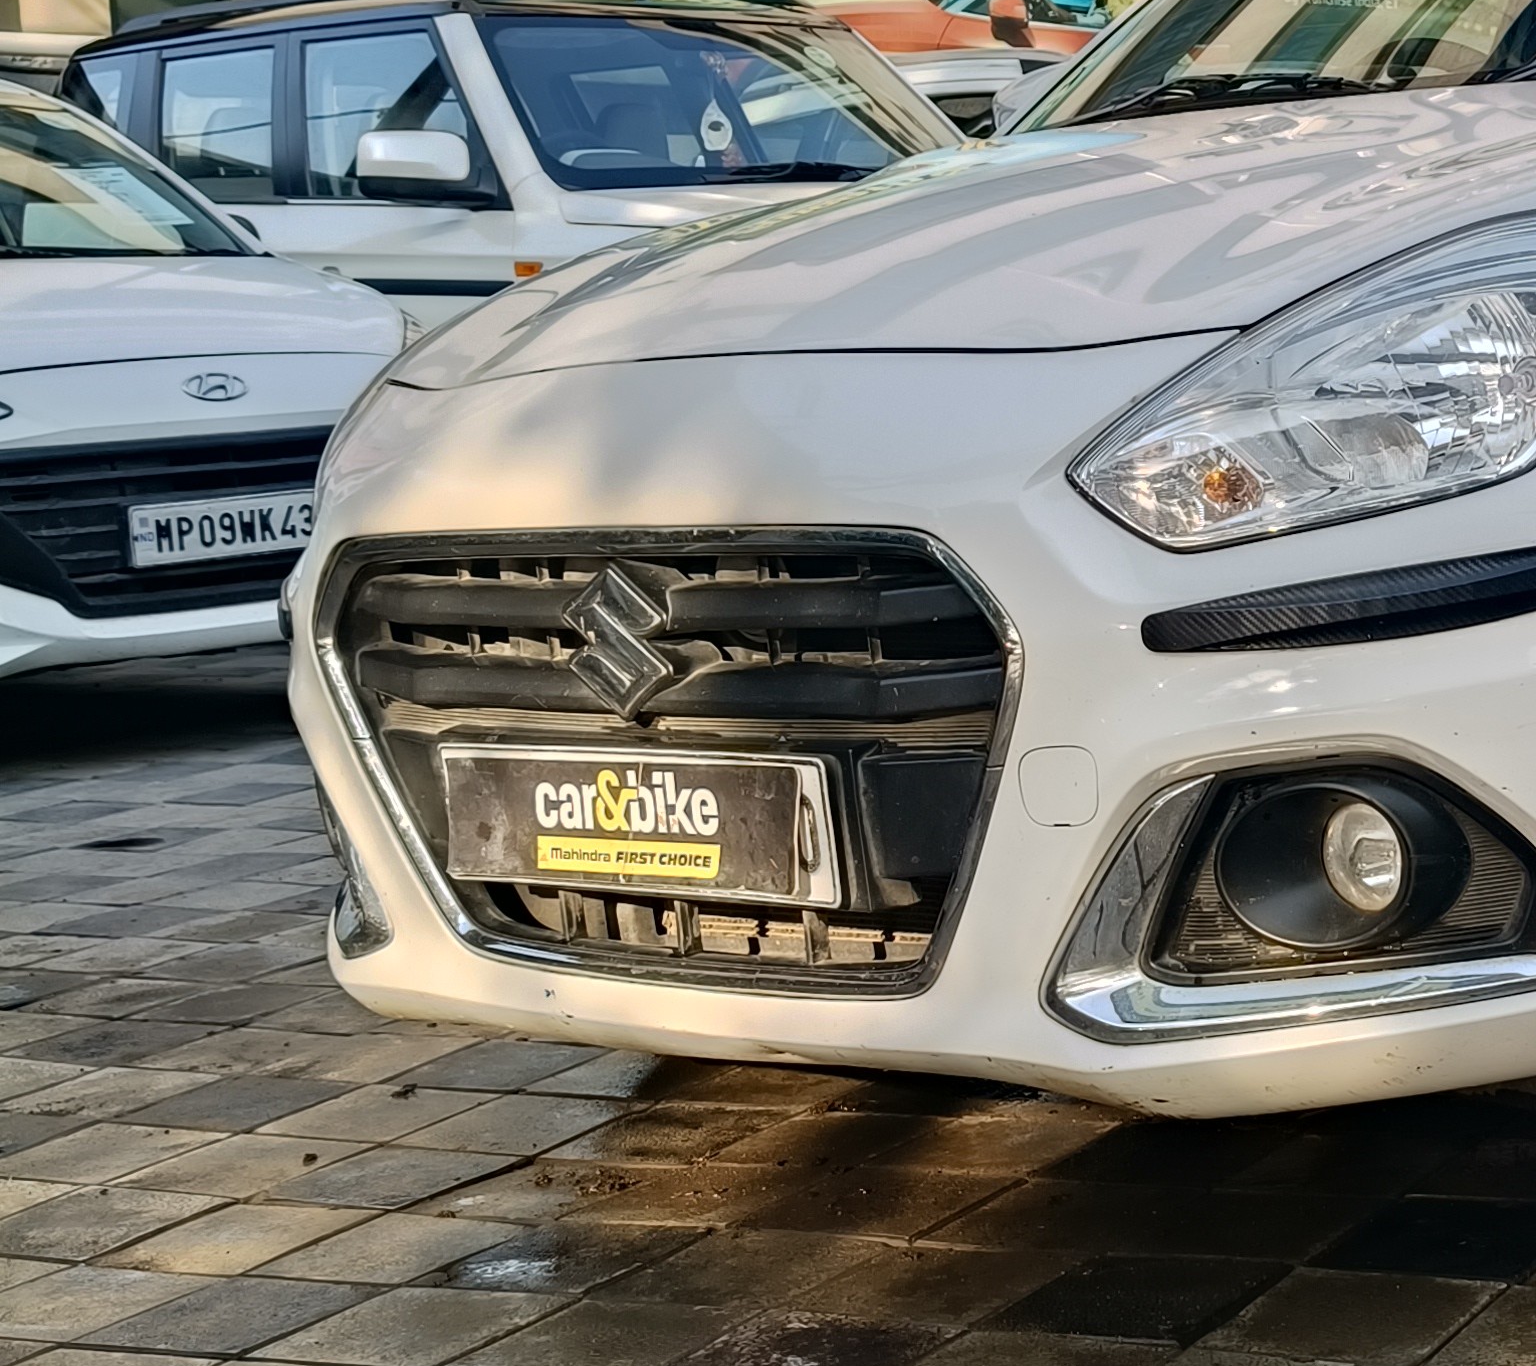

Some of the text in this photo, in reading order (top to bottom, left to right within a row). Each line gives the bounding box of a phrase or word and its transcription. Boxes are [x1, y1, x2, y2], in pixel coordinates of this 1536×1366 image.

[535, 769, 720, 836] car&bike
[550, 847, 713, 869] Mahindra FIRST CHOICE
